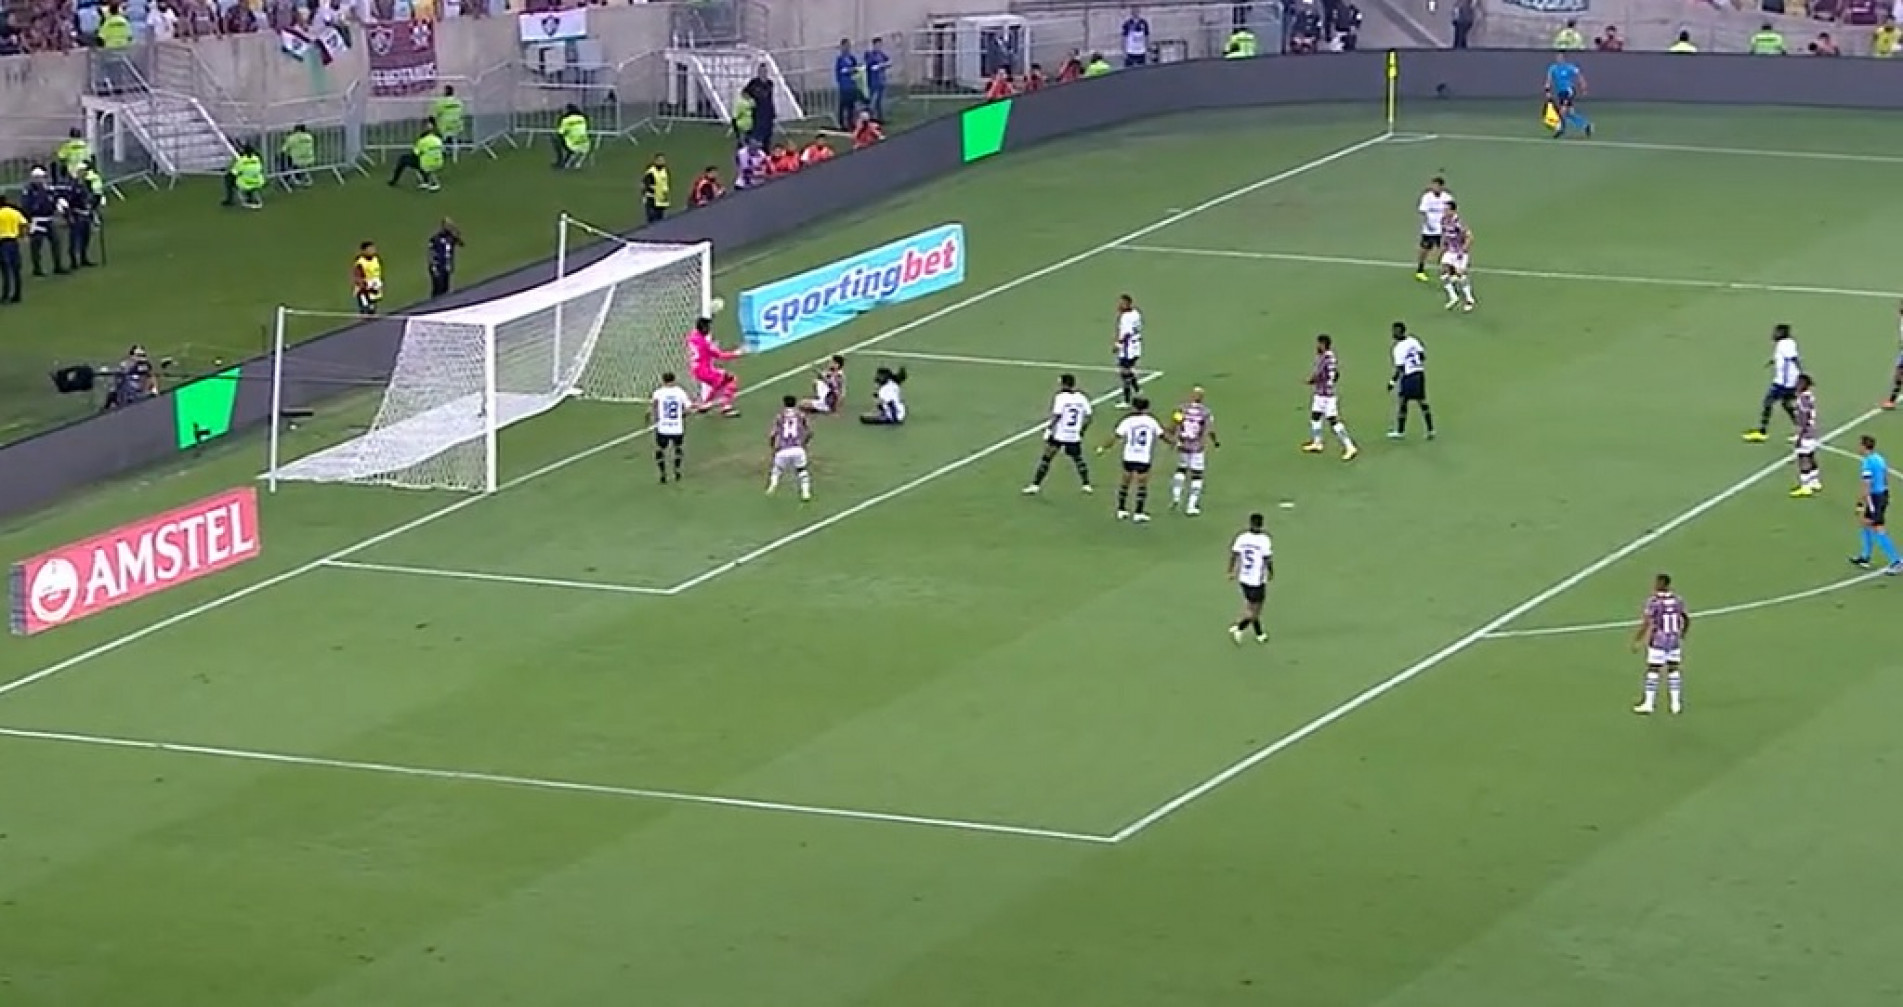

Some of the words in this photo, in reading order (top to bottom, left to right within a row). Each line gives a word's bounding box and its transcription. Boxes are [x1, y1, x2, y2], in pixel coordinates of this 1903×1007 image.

[763, 240, 956, 332] sportingbet
[1066, 408, 1079, 427] 3
[84, 502, 254, 606] AMSTEL
[1243, 549, 1255, 570] 5
[1662, 613, 1678, 633] 11
